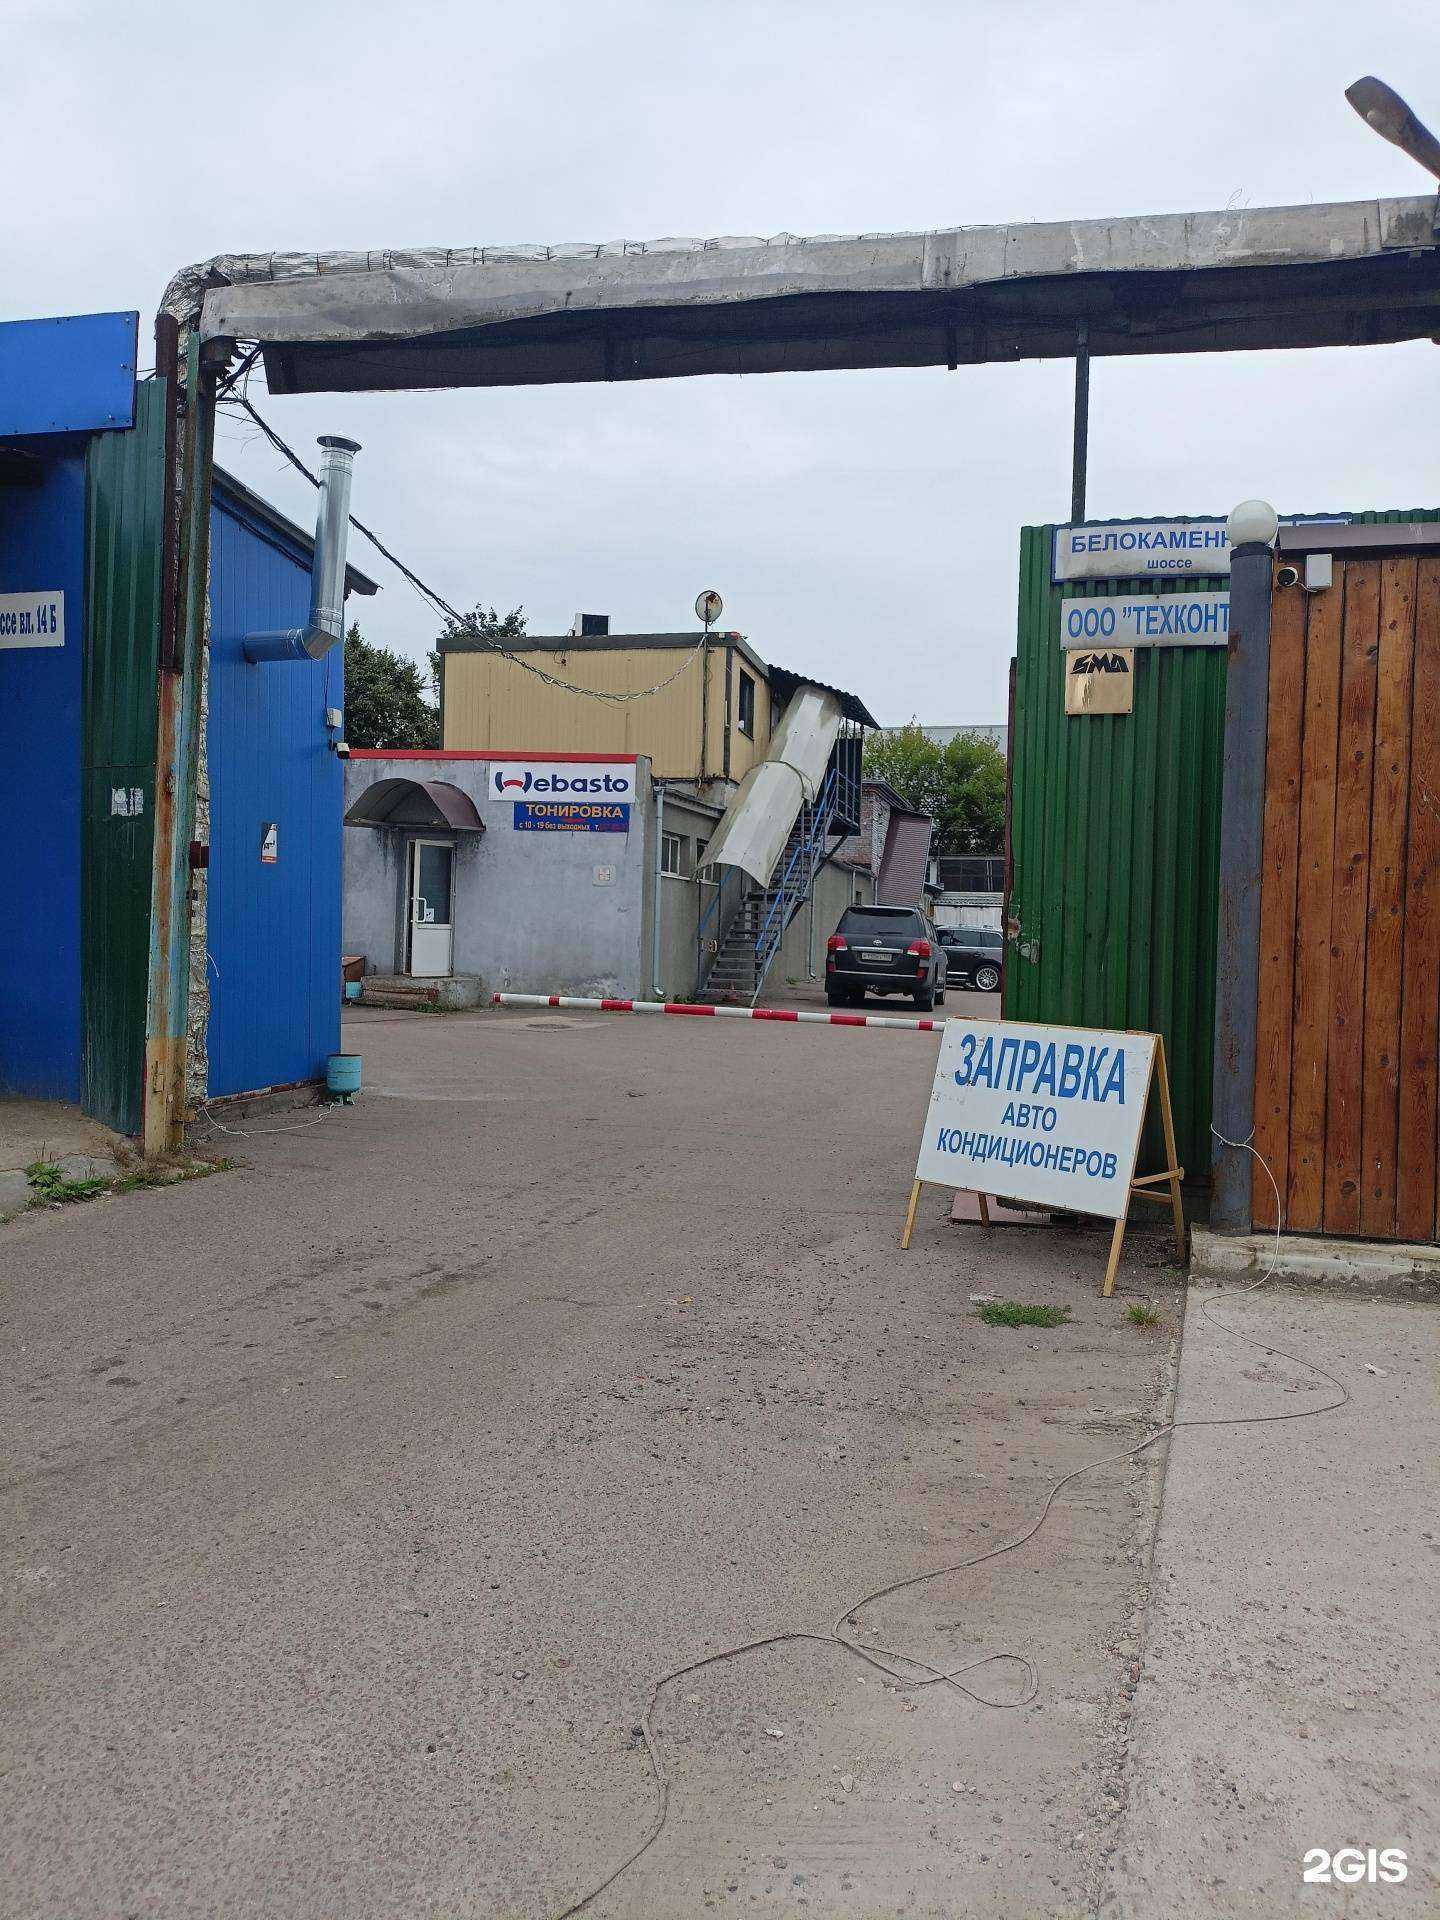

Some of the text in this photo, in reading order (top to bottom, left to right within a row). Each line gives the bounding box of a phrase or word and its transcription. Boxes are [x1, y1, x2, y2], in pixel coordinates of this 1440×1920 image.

[1147, 558, 1193, 569] шоссе
[1067, 607, 1116, 638] ООО
[494, 771, 629, 794] Webasto
[526, 804, 623, 818] ТОНИРОВКА
[955, 1033, 1126, 1104] ЗАПРАВКА
[1000, 1102, 1057, 1131] АВТО
[936, 1128, 1118, 1179] КОНДИЦИОНЕРОВ
